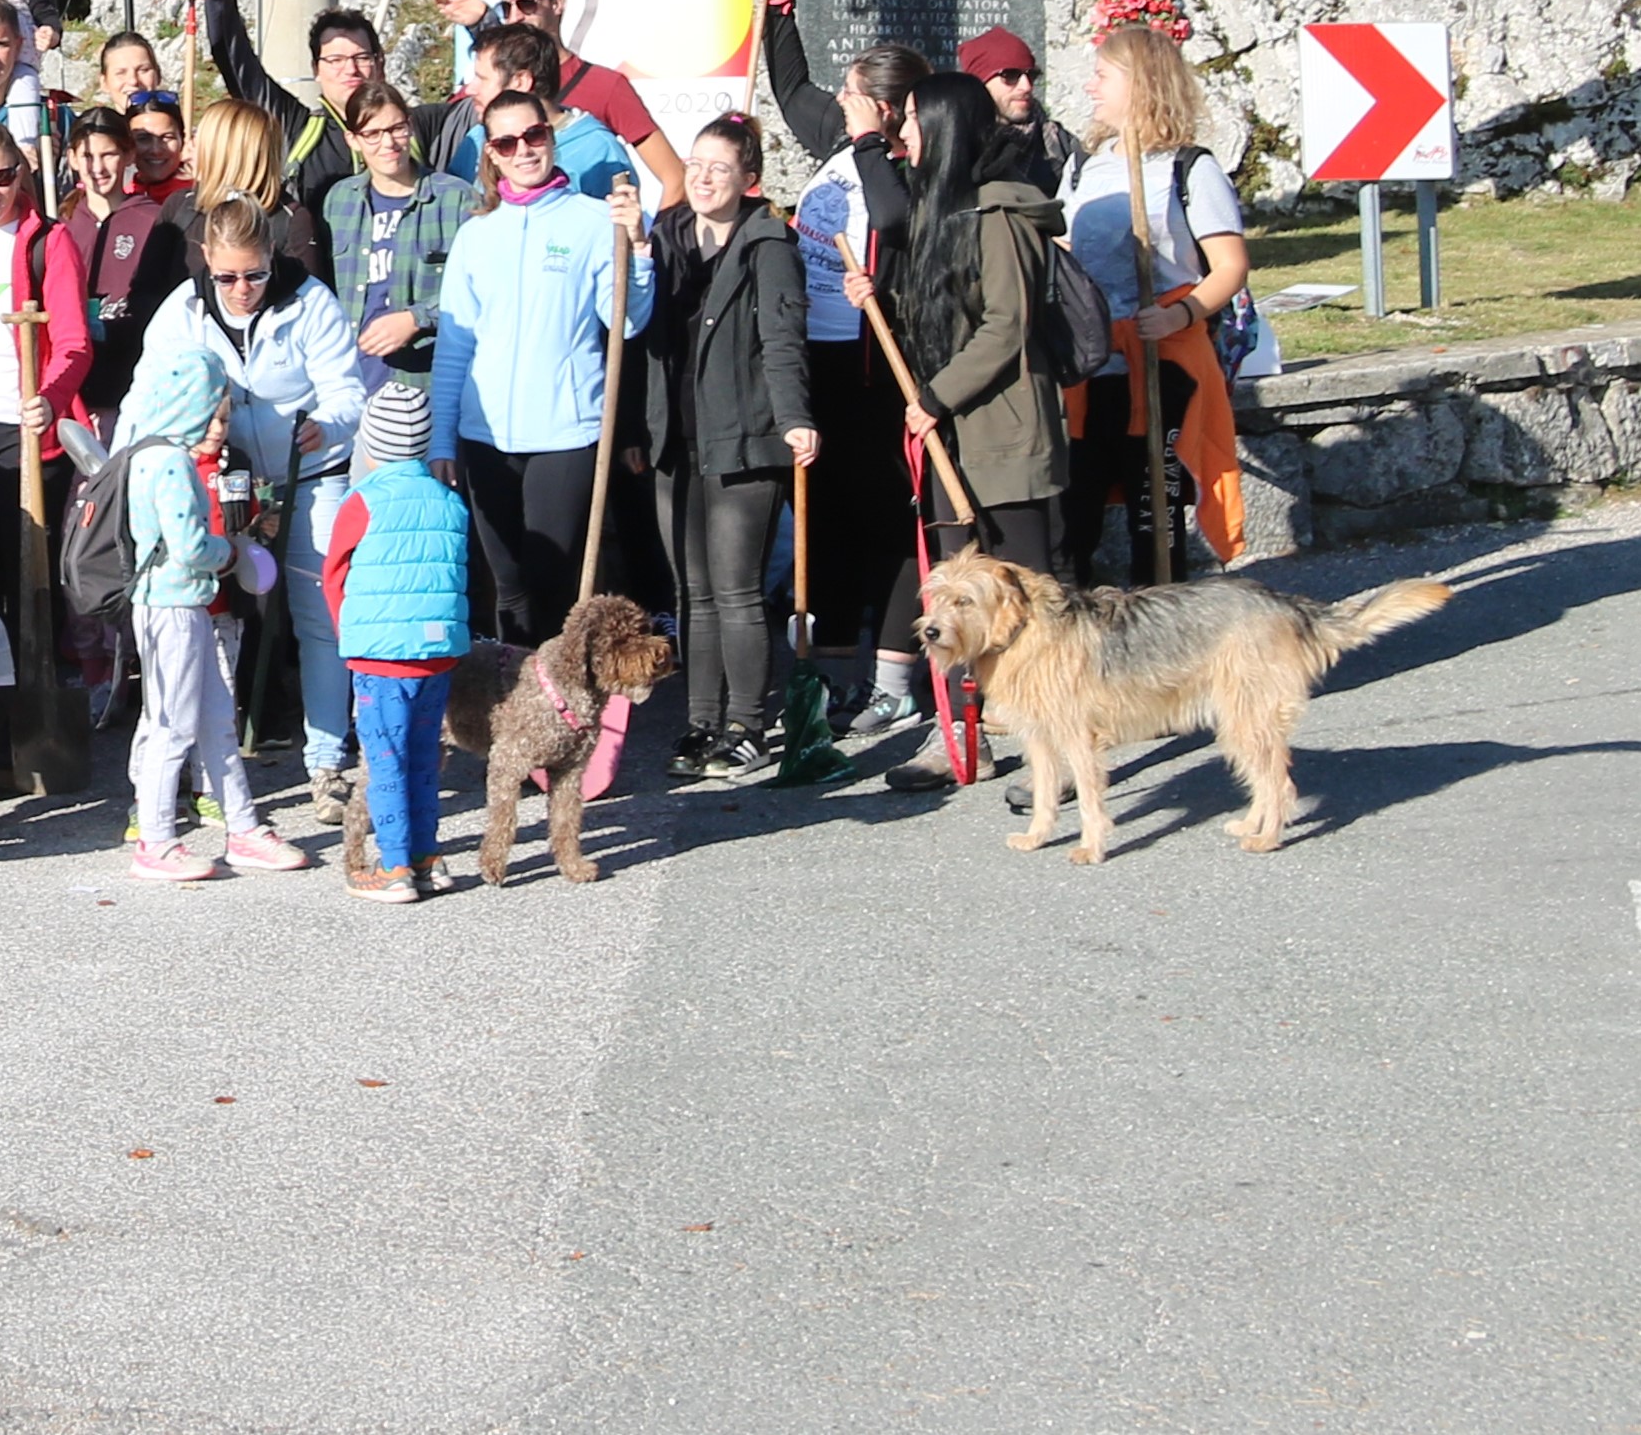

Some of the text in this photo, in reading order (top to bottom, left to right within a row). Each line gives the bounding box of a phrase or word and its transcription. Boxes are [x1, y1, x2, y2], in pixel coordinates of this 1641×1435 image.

[974, 13, 1011, 25] ISTRE
[849, 24, 906, 36] HRABRO
[658, 91, 734, 115] 2020
